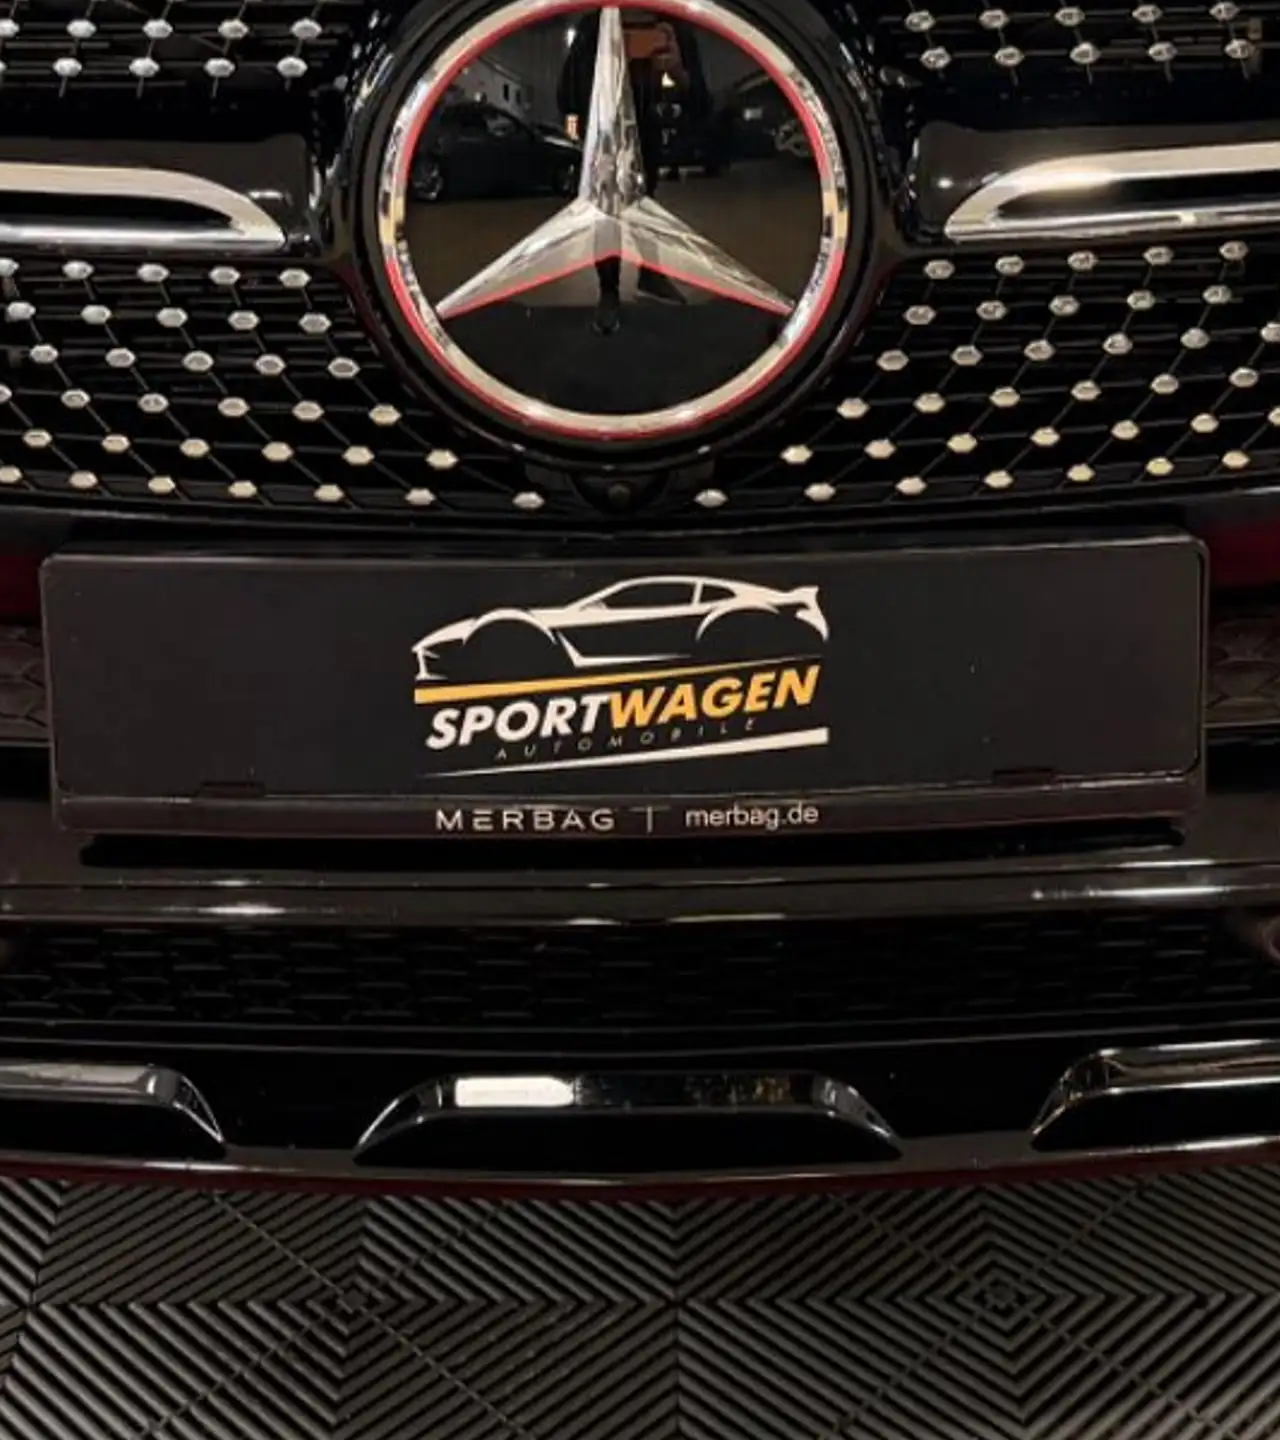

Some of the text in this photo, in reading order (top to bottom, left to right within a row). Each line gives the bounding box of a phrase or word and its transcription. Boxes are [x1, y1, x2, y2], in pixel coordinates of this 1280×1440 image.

[425, 665, 821, 751] SPORTWAGEN
[494, 718, 757, 761] AUTOMOBILE
[435, 800, 820, 834] MERBAG merbag.de
